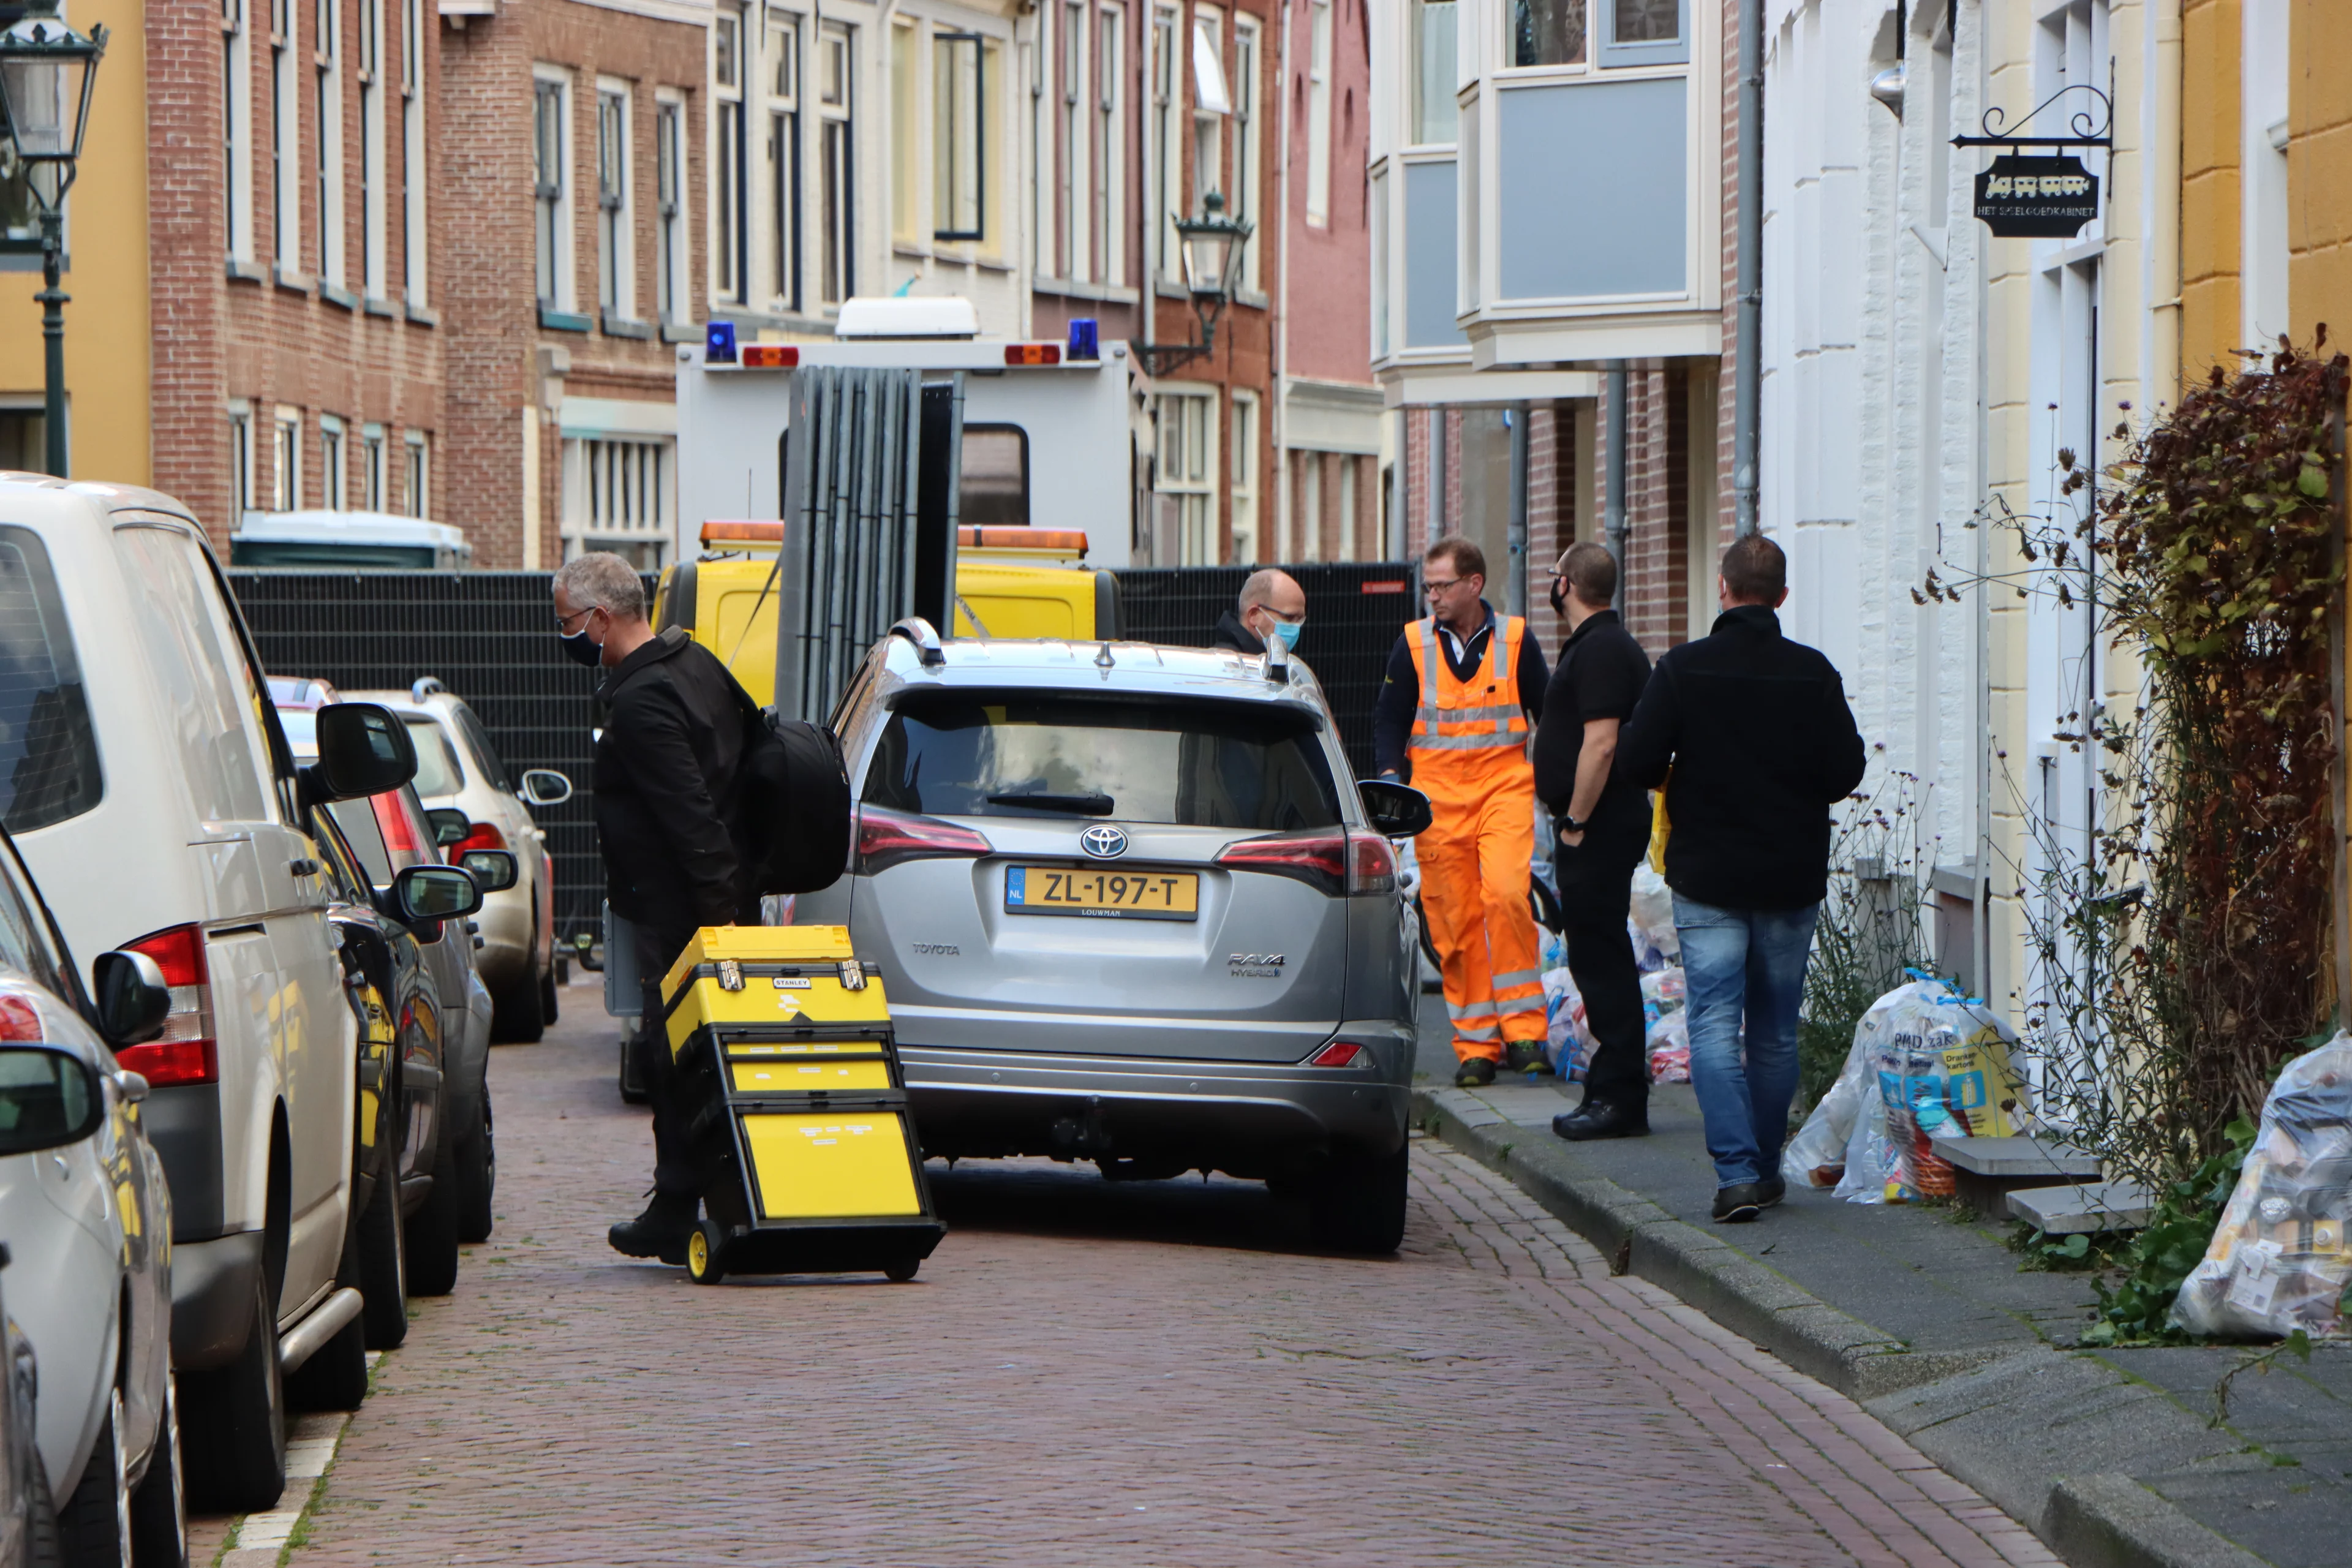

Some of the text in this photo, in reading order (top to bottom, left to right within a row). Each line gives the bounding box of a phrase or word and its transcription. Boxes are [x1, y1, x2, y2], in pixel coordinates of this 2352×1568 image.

[1978, 206, 1996, 216] HET
[1009, 890, 1022, 899] NL
[1044, 874, 1178, 905] ZL-197-T
[913, 943, 960, 956] TOYOTA
[1227, 954, 1286, 965] RAV4
[1231, 968, 1275, 978] HYBRID
[1894, 1031, 1953, 1049] PMD zak
